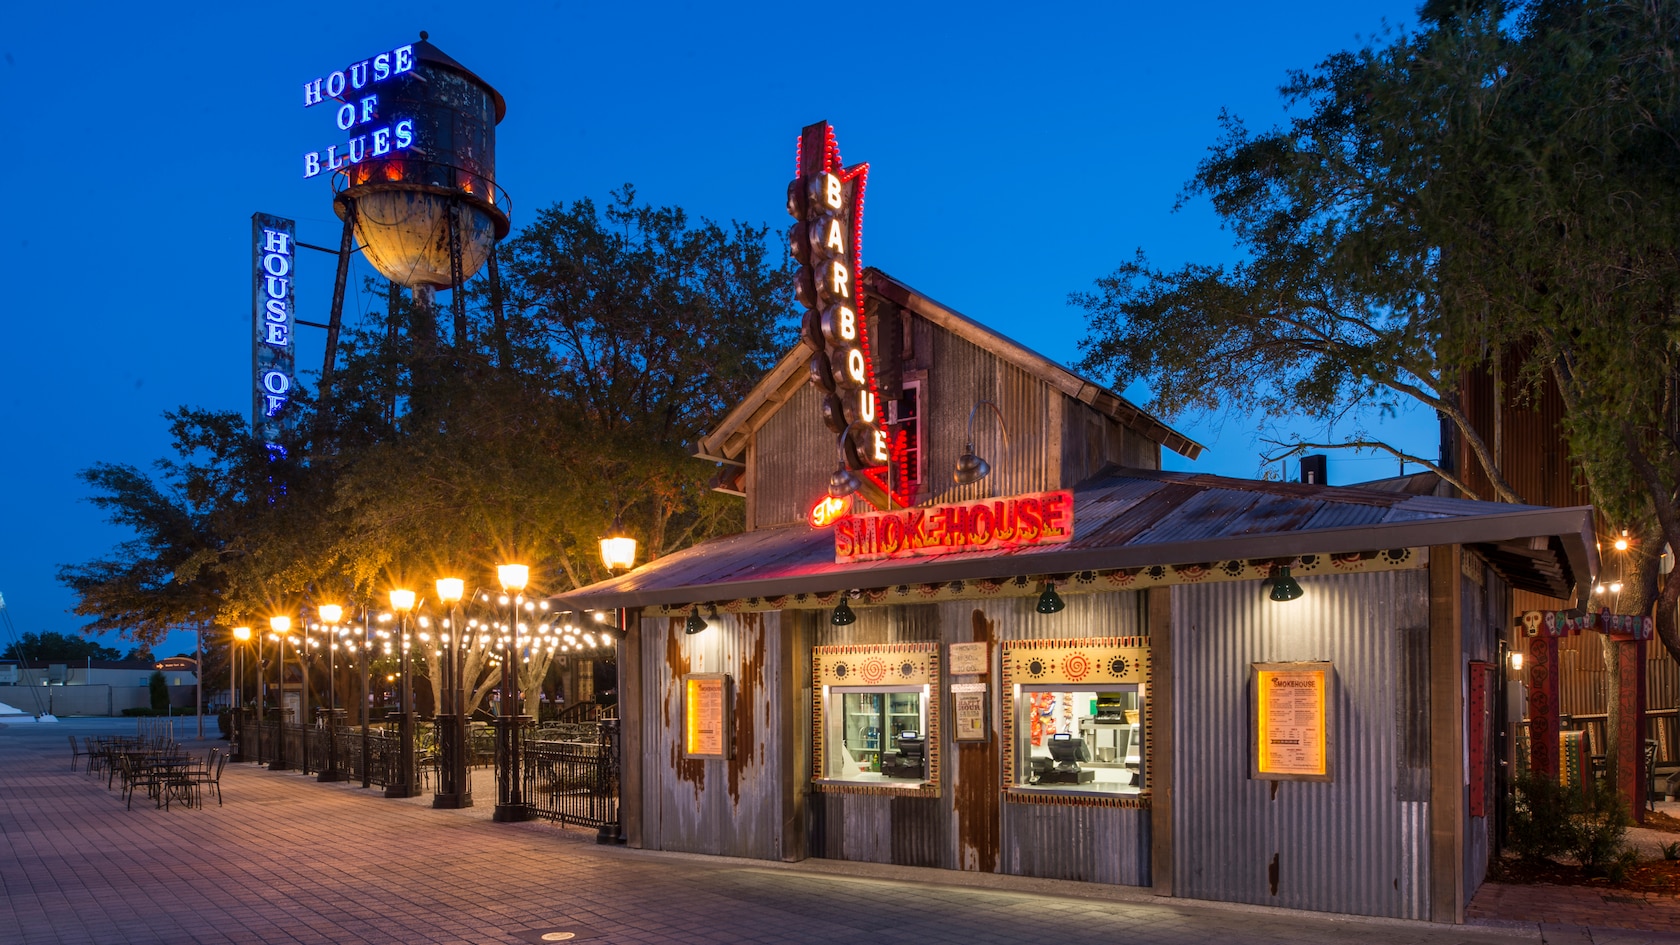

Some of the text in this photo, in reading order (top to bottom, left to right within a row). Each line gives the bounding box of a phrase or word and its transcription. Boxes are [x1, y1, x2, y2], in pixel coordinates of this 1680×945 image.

[304, 44, 412, 107] HOUSE
[336, 94, 377, 130] OF
[303, 119, 412, 179] BLUES
[263, 229, 289, 346] HOUSE
[827, 173, 888, 461] BARBQUE
[263, 371, 289, 417] OF
[812, 496, 844, 526] The
[835, 494, 1065, 557] SMOKEHOUSE
[1273, 680, 1316, 688] SMOKEHOUSE
